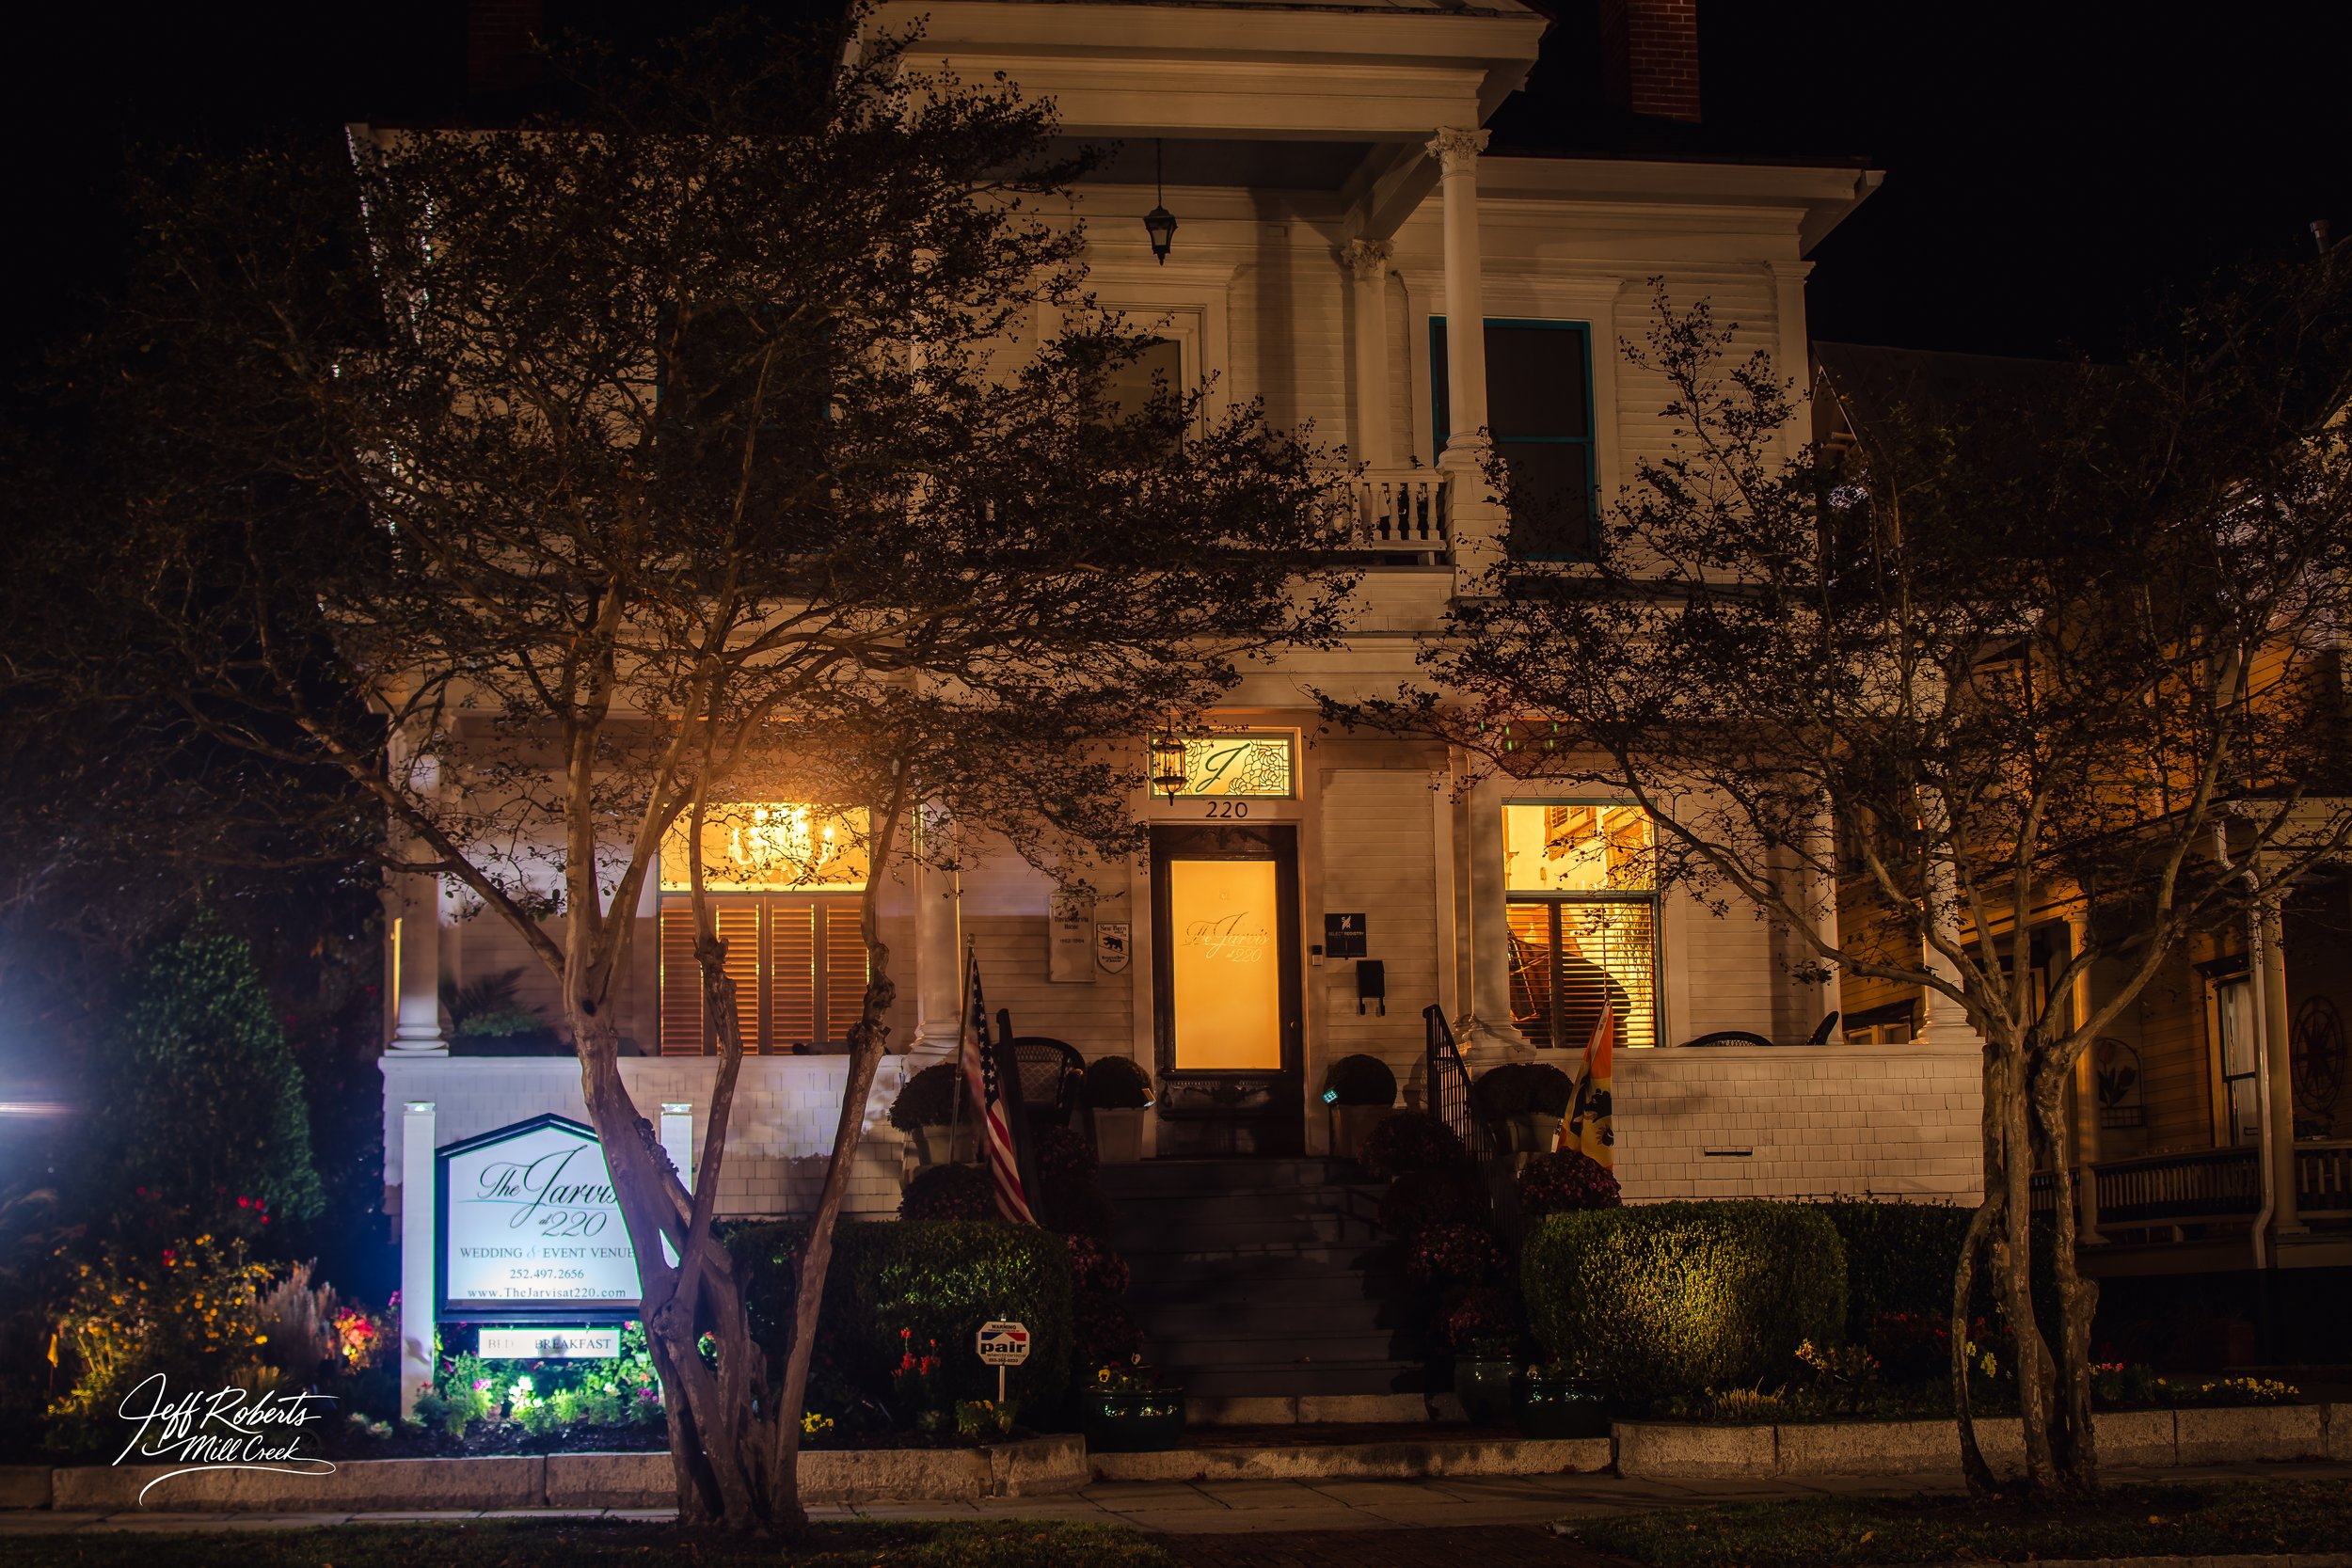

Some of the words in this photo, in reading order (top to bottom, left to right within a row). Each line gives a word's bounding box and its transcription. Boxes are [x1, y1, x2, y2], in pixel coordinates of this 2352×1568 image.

[1205, 800, 1248, 818] 220
[1232, 948, 1263, 963] 220
[477, 1161, 522, 1199] The
[510, 1144, 618, 1228] Jarvis
[538, 1213, 552, 1227] at
[541, 1212, 607, 1237] 220
[460, 1247, 523, 1259] WEDDING
[542, 1247, 586, 1259] EVENT
[591, 1247, 635, 1259] VENUE
[509, 1268, 585, 1280] 252.497.2656
[467, 1287, 627, 1299] www.TheJarvisat220.com
[534, 1338, 612, 1350] BREAKFAST
[980, 1341, 1026, 1354] pair
